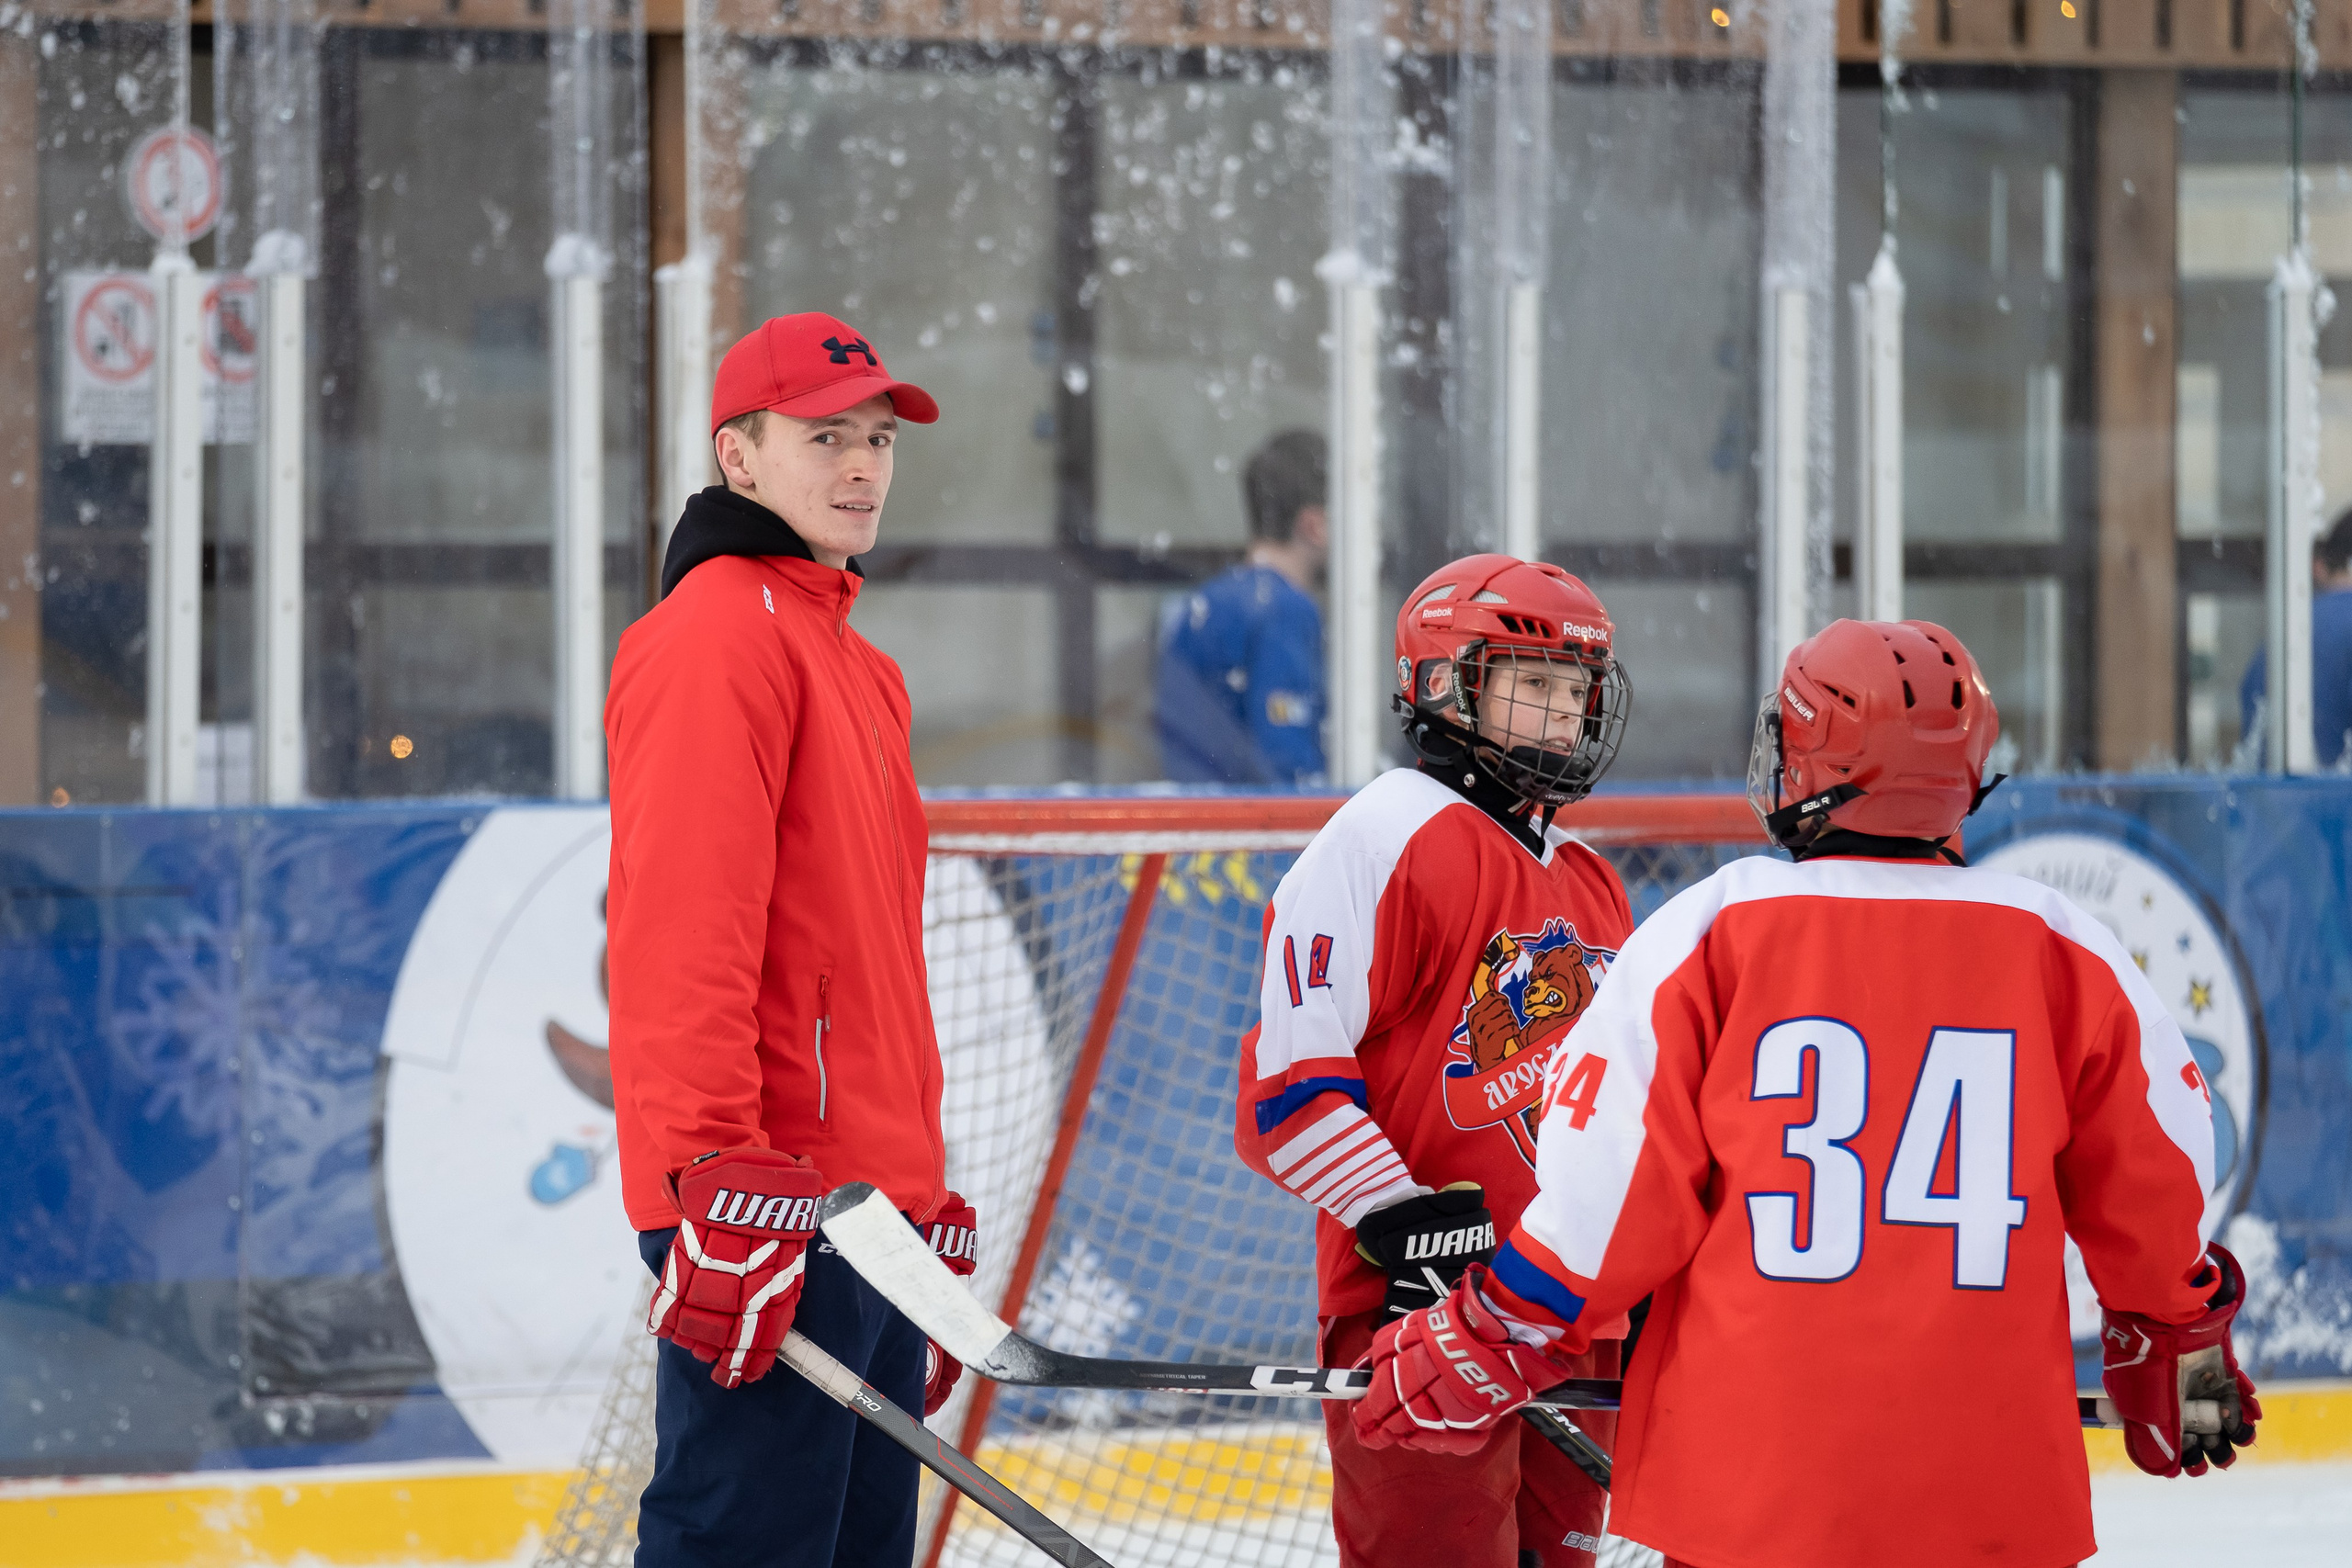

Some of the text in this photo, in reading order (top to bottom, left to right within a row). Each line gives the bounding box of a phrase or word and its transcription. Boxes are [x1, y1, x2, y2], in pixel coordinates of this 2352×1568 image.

[1422, 607, 1453, 619] Reebok
[1563, 621, 1608, 642] Reebok
[1452, 671, 1466, 711] Reebok
[1783, 686, 1815, 721] BAUER
[1801, 795, 1830, 813] BAUR
[1744, 1015, 2029, 1292] 34
[1426, 1304, 1512, 1407] AUER
